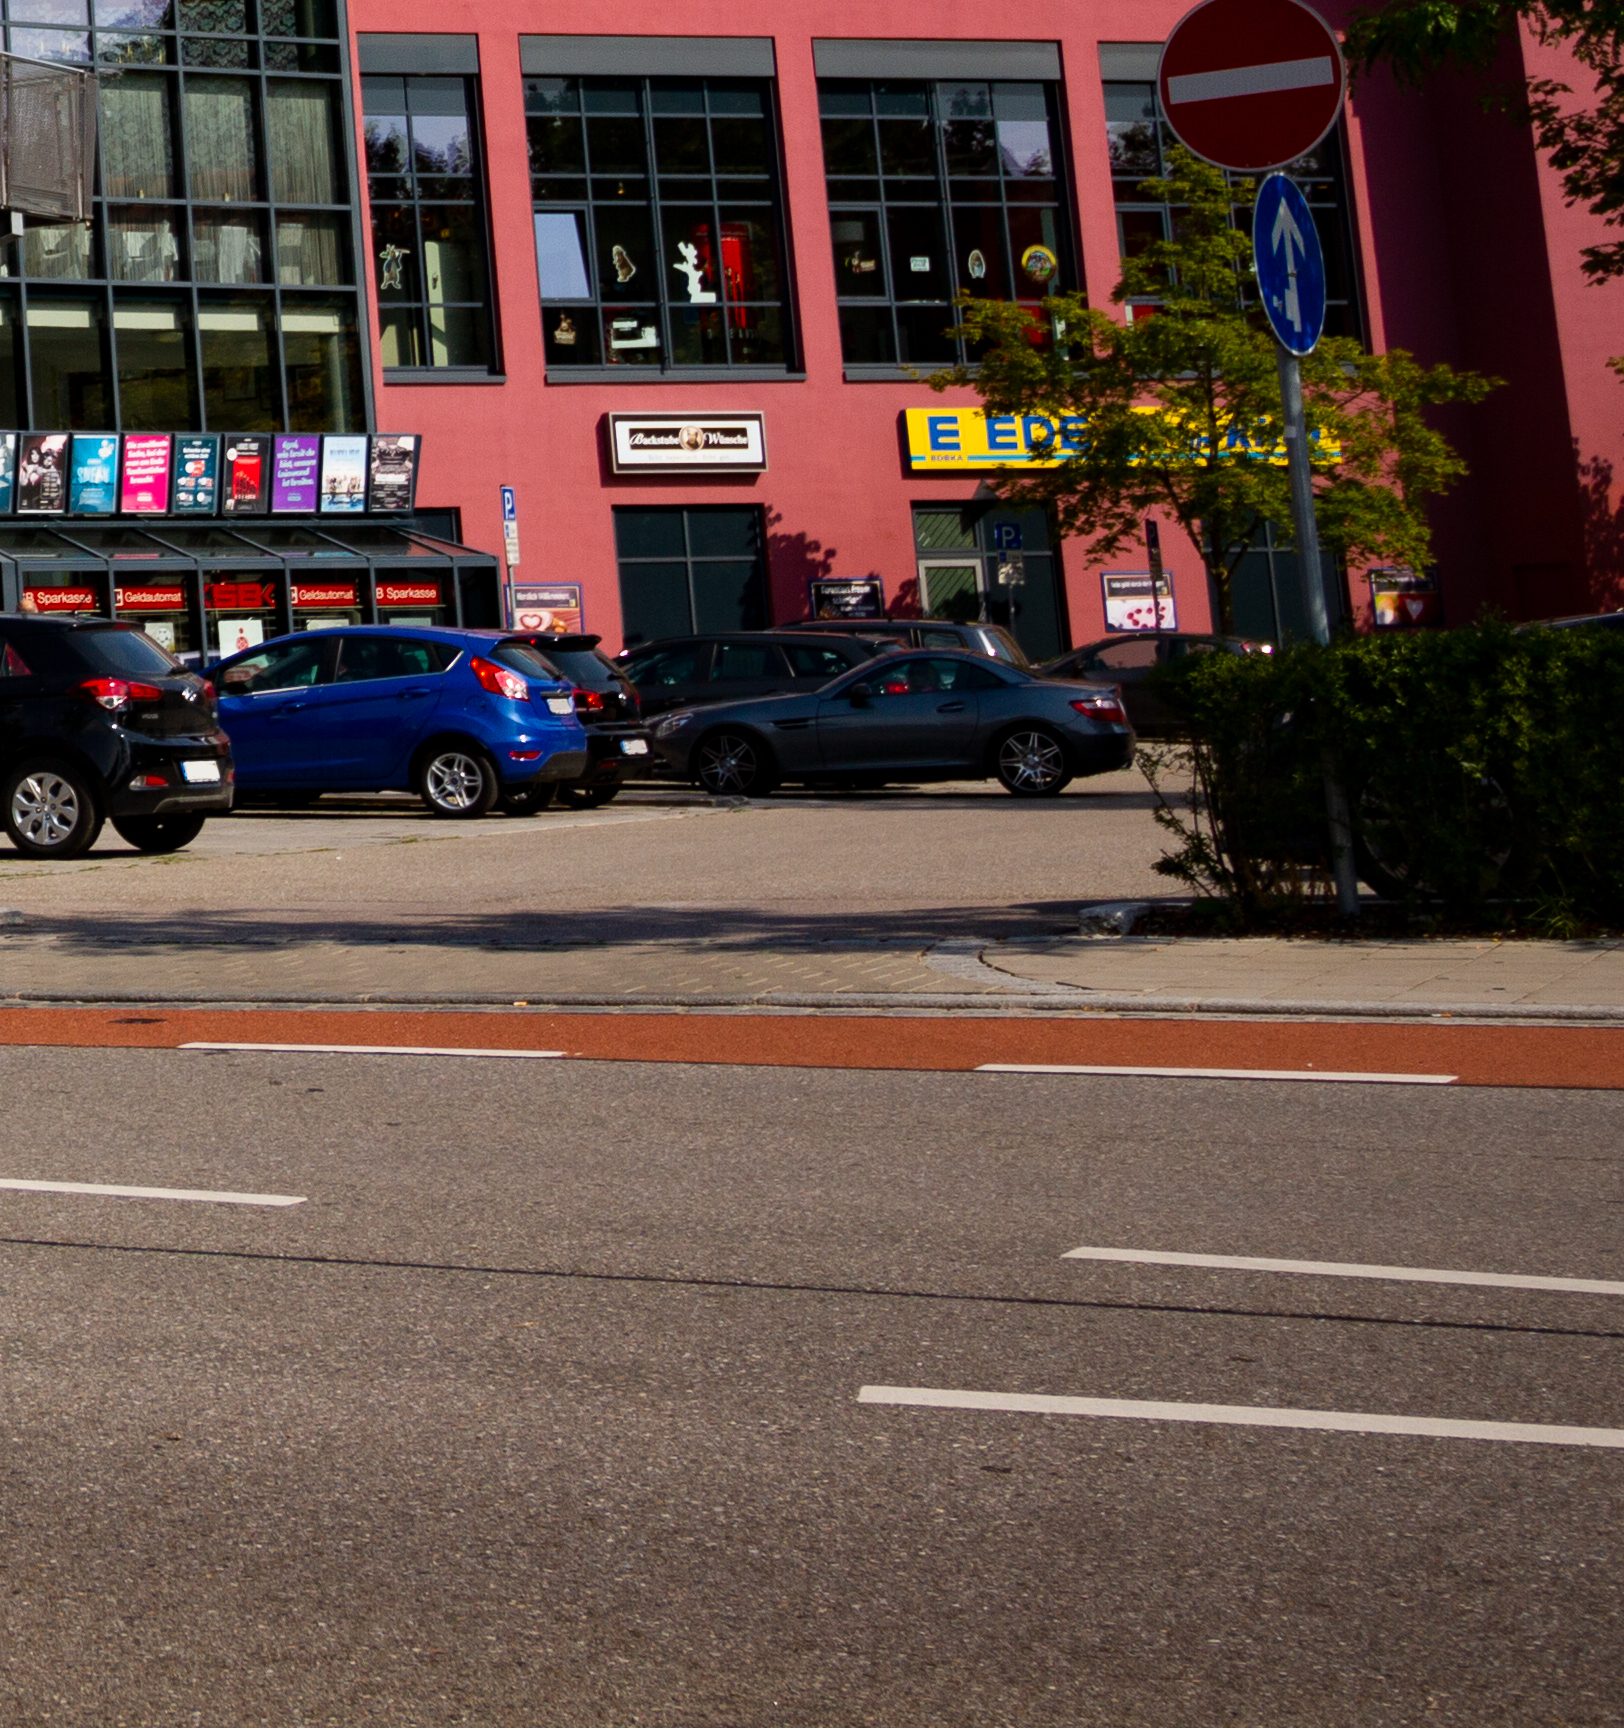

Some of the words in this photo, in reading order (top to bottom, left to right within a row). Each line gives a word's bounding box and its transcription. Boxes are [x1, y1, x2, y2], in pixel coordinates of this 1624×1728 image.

[927, 415, 962, 451] E
[504, 491, 513, 520] P
[1002, 526, 1015, 548] P
[23, 592, 34, 602] B
[37, 591, 93, 605] Sparkasse
[125, 591, 182, 603] Geldautomat
[299, 589, 354, 600] Geldautomat
[386, 588, 437, 601] Sparkasse
